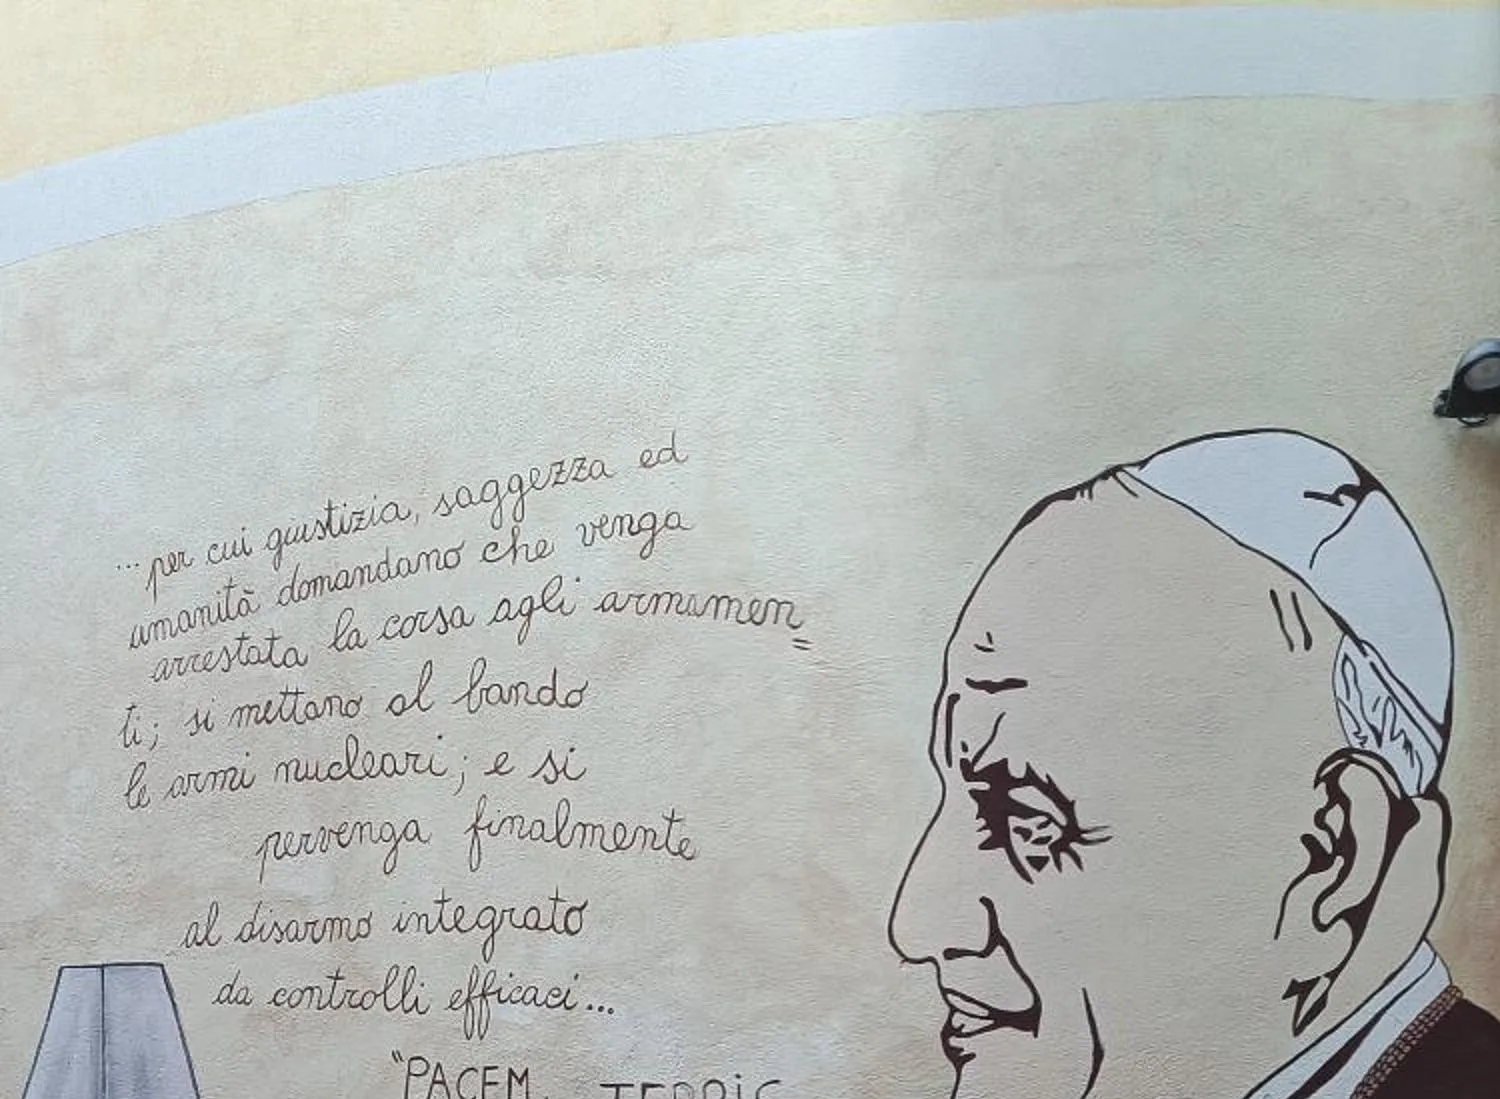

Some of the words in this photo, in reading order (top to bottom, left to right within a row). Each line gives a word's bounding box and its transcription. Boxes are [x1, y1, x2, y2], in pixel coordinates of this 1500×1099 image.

[206, 526, 253, 566] cui
[432, 456, 616, 530] saggezza
[639, 430, 688, 469] ed
[130, 577, 261, 650] umanità
[276, 541, 465, 608] domandano
[480, 526, 555, 566] che
[576, 510, 692, 560] venga
[151, 628, 309, 683] arrestata
[328, 608, 368, 652] la
[377, 604, 474, 641] corsa
[486, 575, 580, 645] agli
[184, 698, 215, 737] si
[228, 684, 363, 728] mettano
[386, 660, 435, 716] al
[452, 657, 589, 713] bando
[124, 761, 151, 810] le
[164, 751, 256, 801] armi
[484, 751, 516, 775] e
[527, 747, 587, 785] si
[255, 819, 431, 883] pervenga
[464, 794, 697, 872] finalmente
[181, 901, 222, 948] al
[233, 900, 373, 944] disarmo
[392, 886, 589, 963] integrato
[212, 969, 253, 1005] da
[266, 963, 430, 1015] controlli
